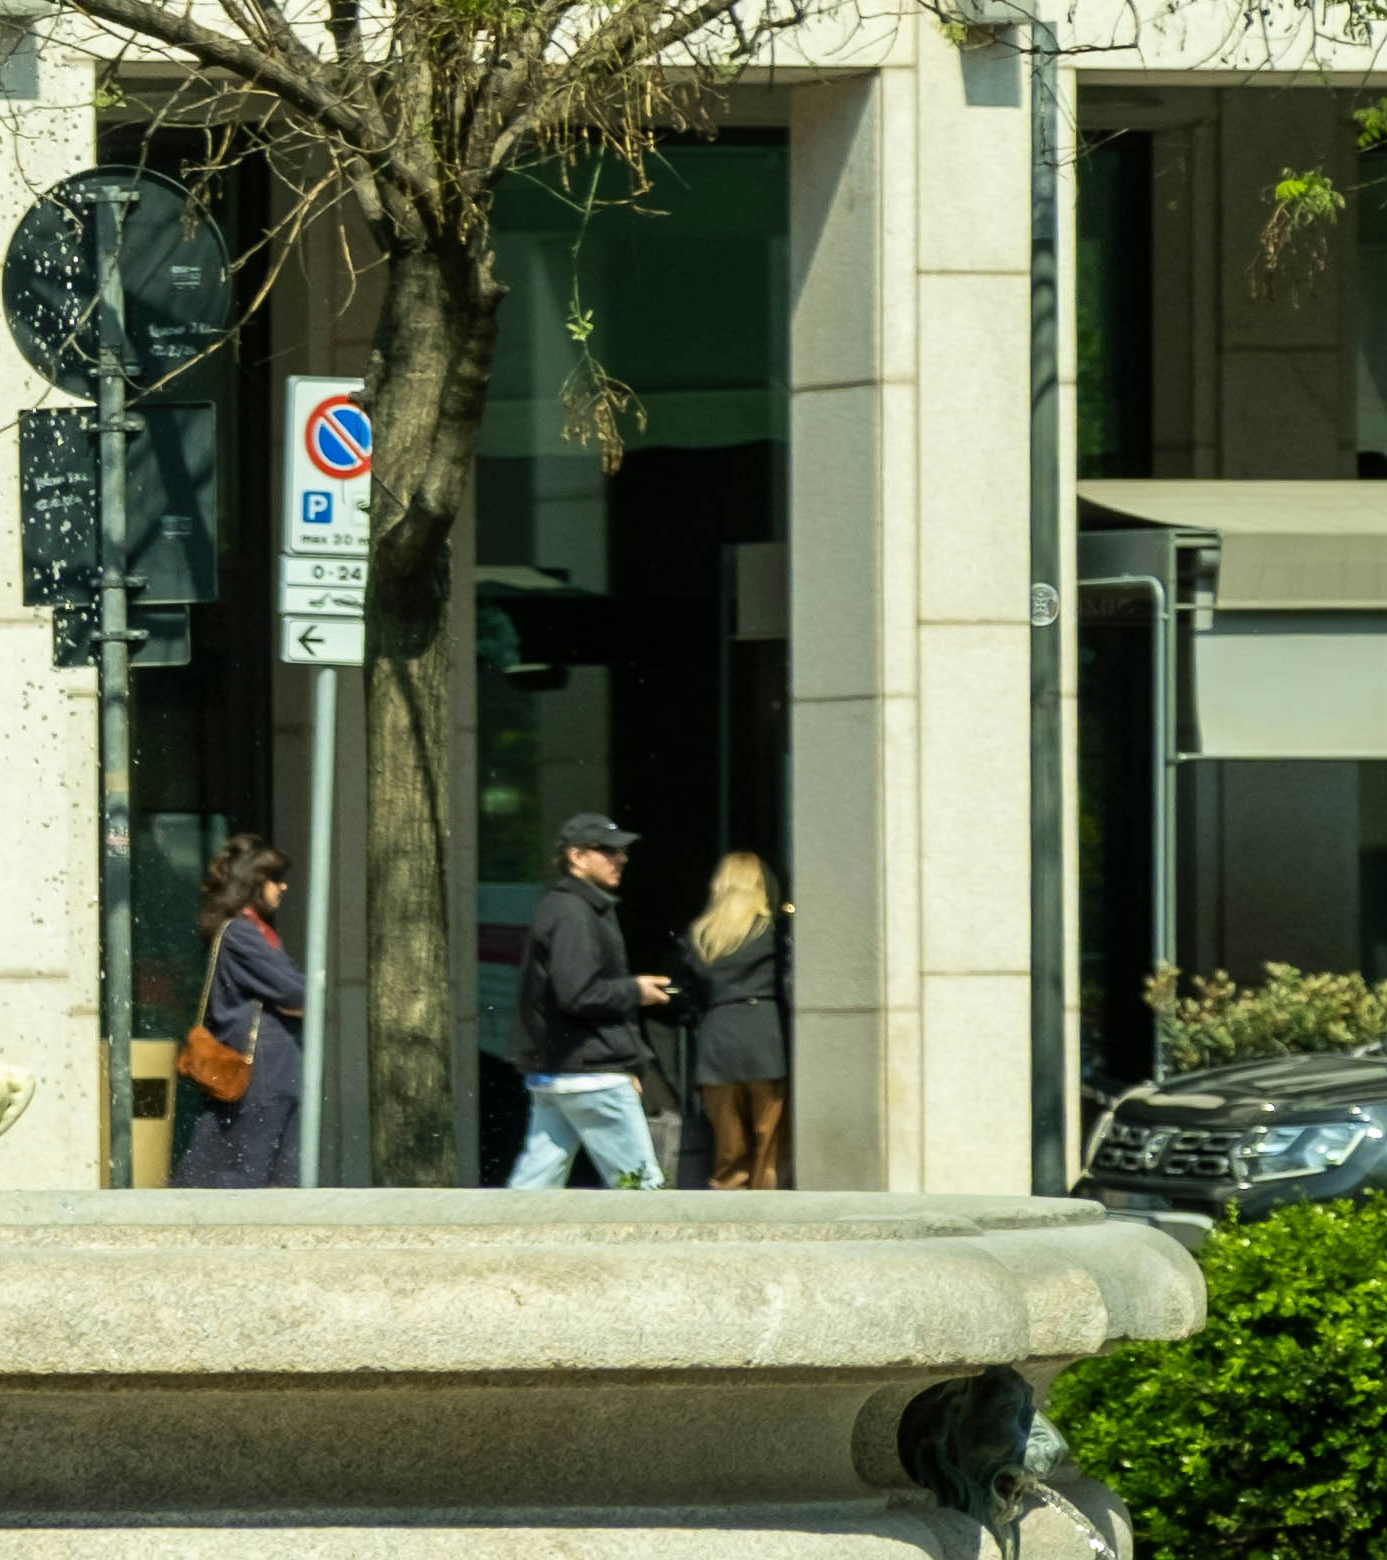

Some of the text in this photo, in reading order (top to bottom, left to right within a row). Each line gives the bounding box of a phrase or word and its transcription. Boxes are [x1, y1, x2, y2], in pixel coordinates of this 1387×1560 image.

[308, 494, 328, 520] P
[301, 534, 327, 544] max
[332, 534, 353, 546] 30
